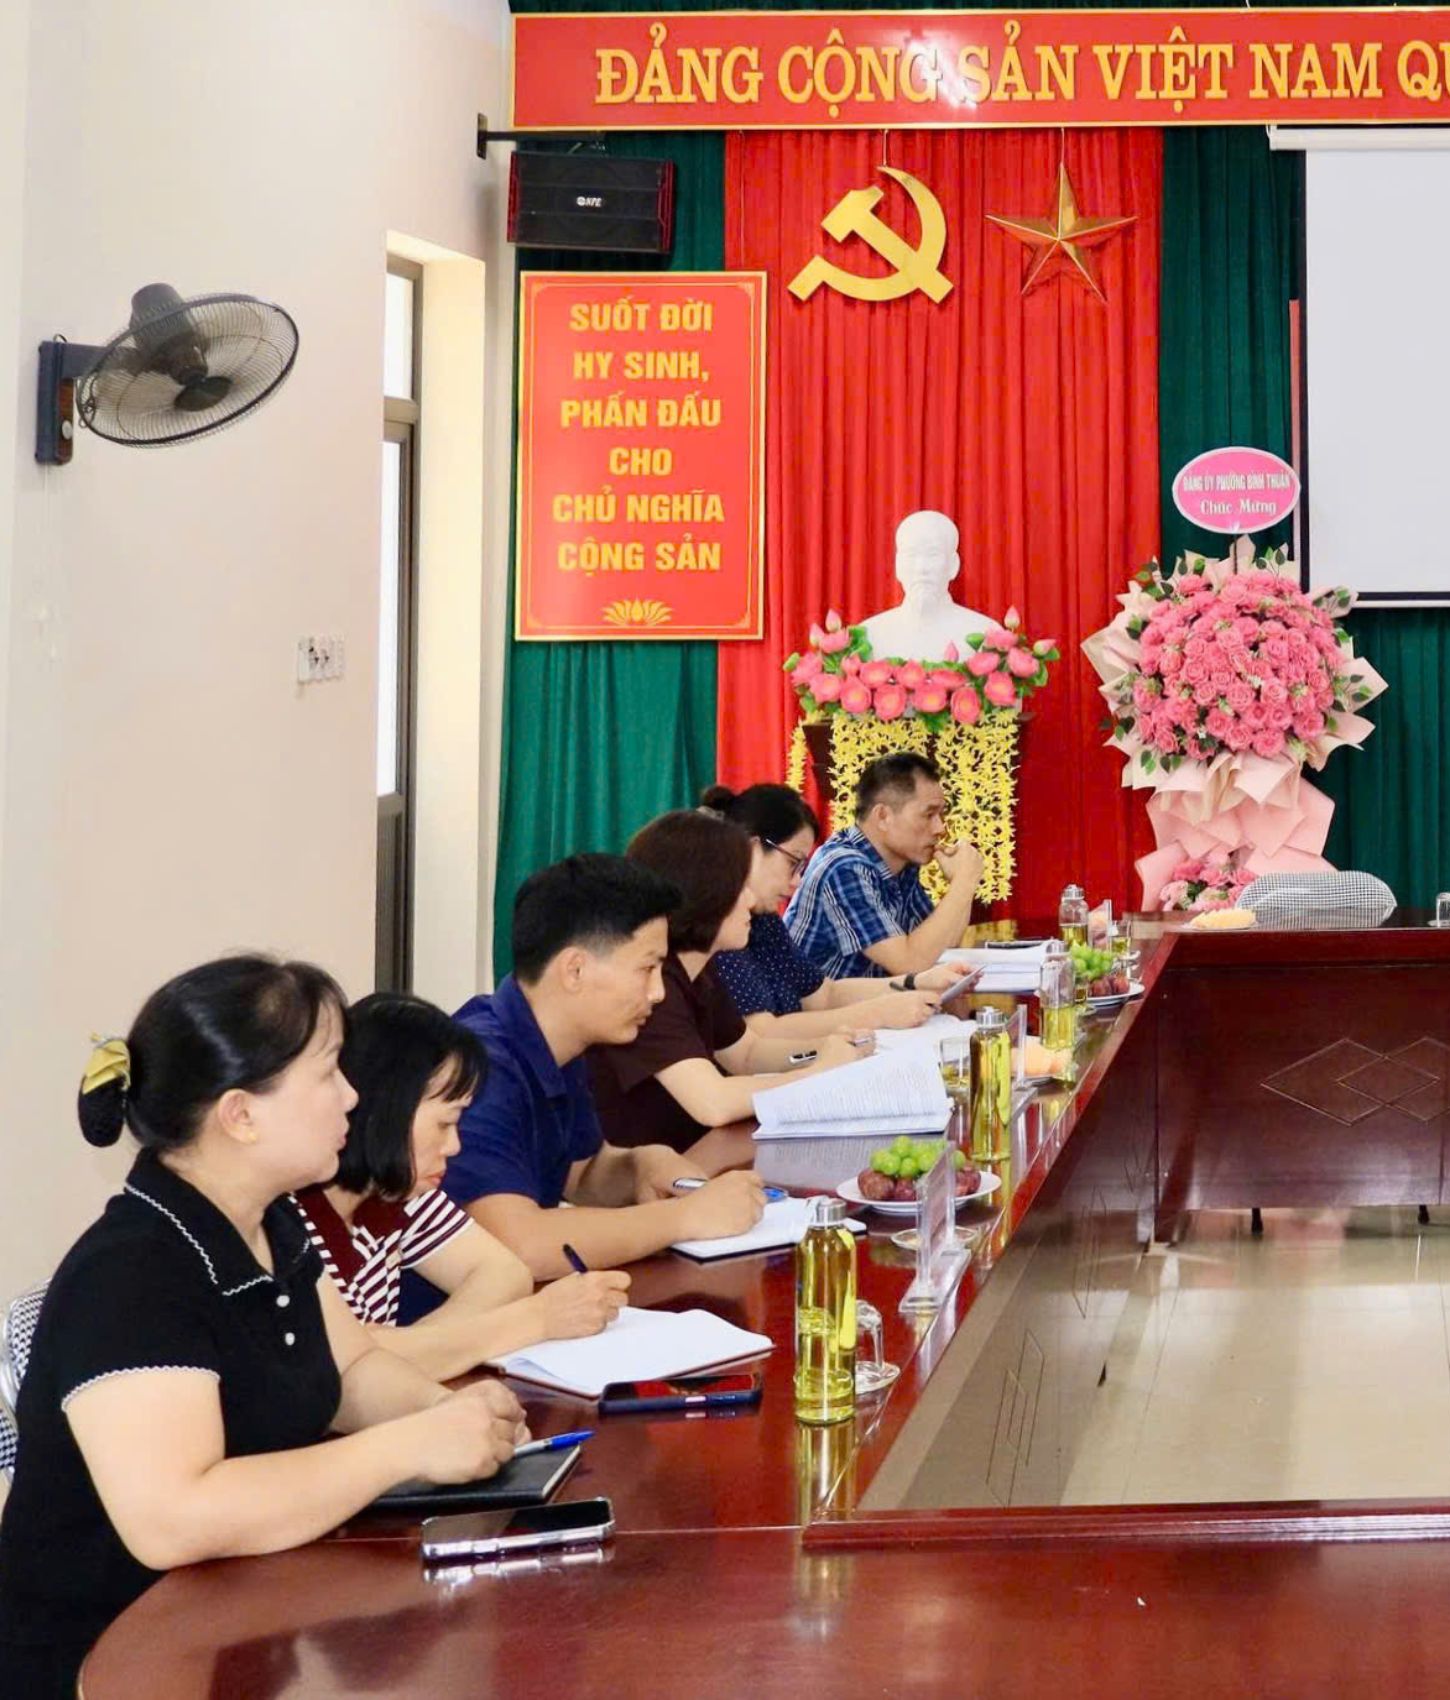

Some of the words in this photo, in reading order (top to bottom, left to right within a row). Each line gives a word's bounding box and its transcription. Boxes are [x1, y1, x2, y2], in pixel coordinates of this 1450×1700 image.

[595, 22, 764, 104] ĐẢNG
[777, 28, 943, 118] CỘNG
[957, 20, 1079, 104] SẢN
[1092, 26, 1234, 113] VIỆT
[1248, 42, 1383, 99] NAM
[569, 295, 650, 332] SUỐT
[659, 299, 713, 332] ĐỜI
[572, 352, 613, 380] HY
[623, 352, 709, 382] SINH,
[560, 391, 647, 428] PHẤN
[657, 391, 721, 427] ĐẤU
[609, 447, 672, 476] CHO
[552, 485, 616, 523] CHỦ
[626, 489, 725, 522] NGHĨA
[556, 537, 644, 577] CỘNG
[655, 533, 721, 571] SẢN
